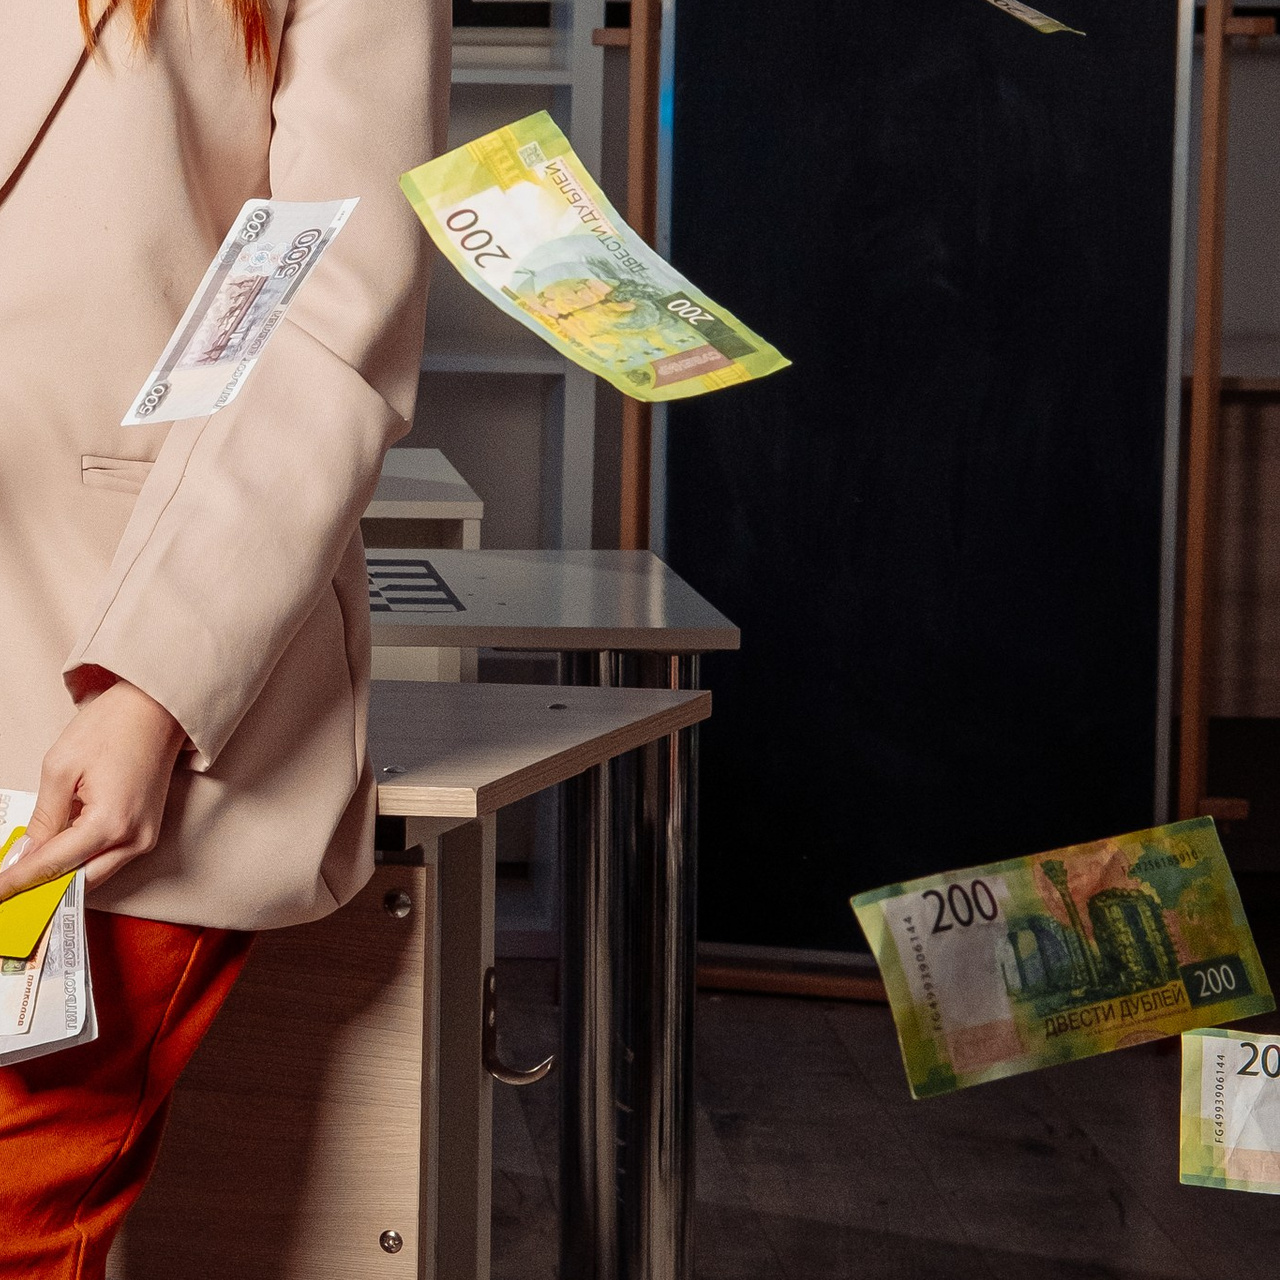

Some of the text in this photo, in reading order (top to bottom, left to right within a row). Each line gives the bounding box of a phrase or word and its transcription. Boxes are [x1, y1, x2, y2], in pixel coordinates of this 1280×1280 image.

[544, 160, 601, 226] ДУБЛЕЙ
[241, 209, 268, 242] 500
[445, 207, 511, 270] 200
[591, 223, 651, 274] ДВЕСТИ
[273, 228, 322, 281] 500
[666, 298, 715, 326] 200
[138, 384, 166, 416] 500
[922, 878, 999, 936] 200
[17, 974, 35, 1027] ПРИКОЛОВ
[1193, 963, 1237, 999] 200
[1044, 1004, 1116, 1040] ДВЕСТИ
[1118, 982, 1187, 1020] ДУБЛЕЙ
[1214, 1053, 1226, 1145] FG4993906144
